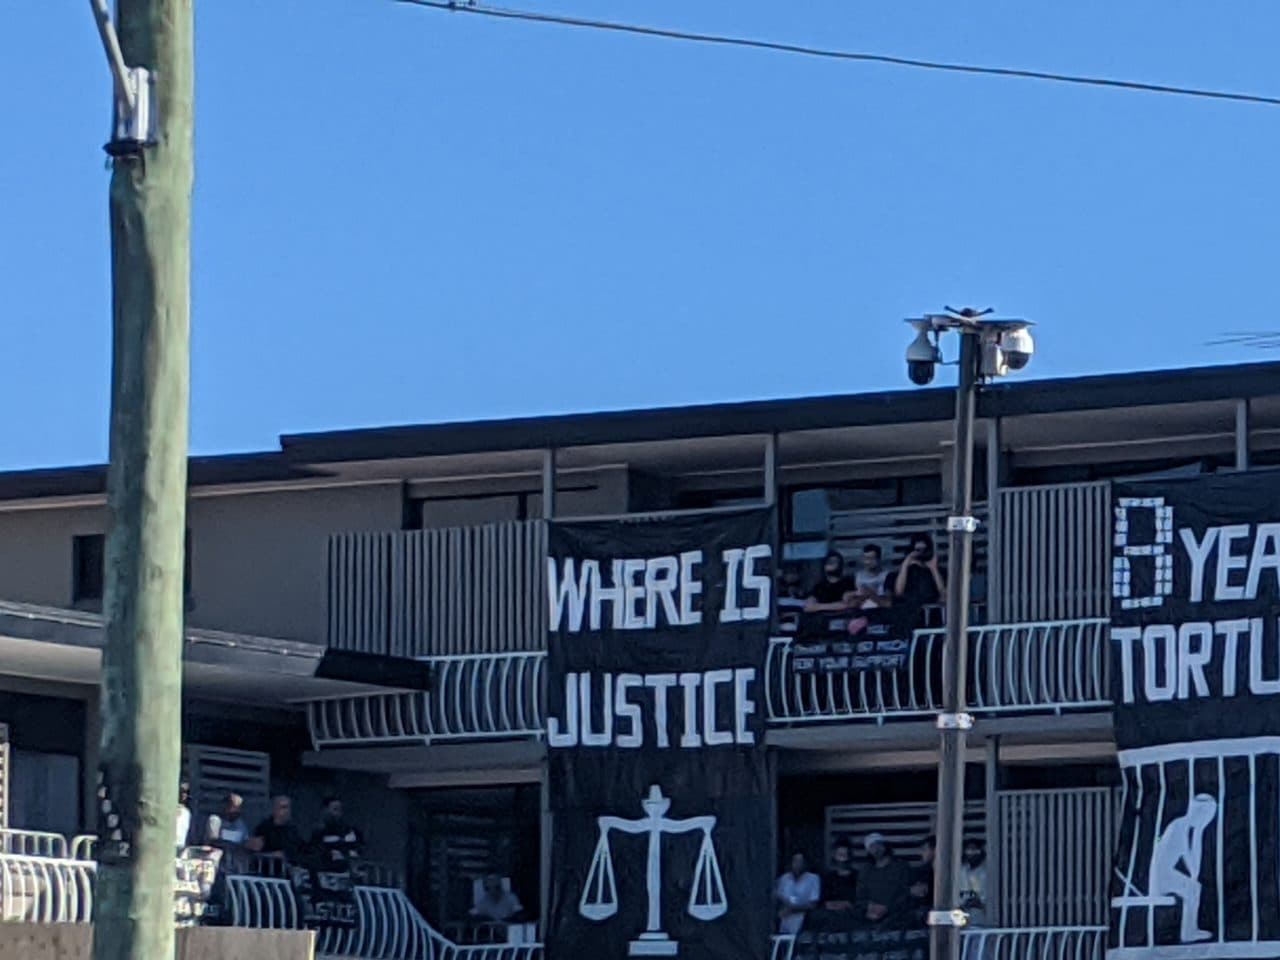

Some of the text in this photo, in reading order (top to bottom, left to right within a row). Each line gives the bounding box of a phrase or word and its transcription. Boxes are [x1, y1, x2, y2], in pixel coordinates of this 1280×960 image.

[547, 544, 772, 632] WHERE IS
[1112, 497, 1174, 609] 8
[547, 668, 756, 748] JUSTICE
